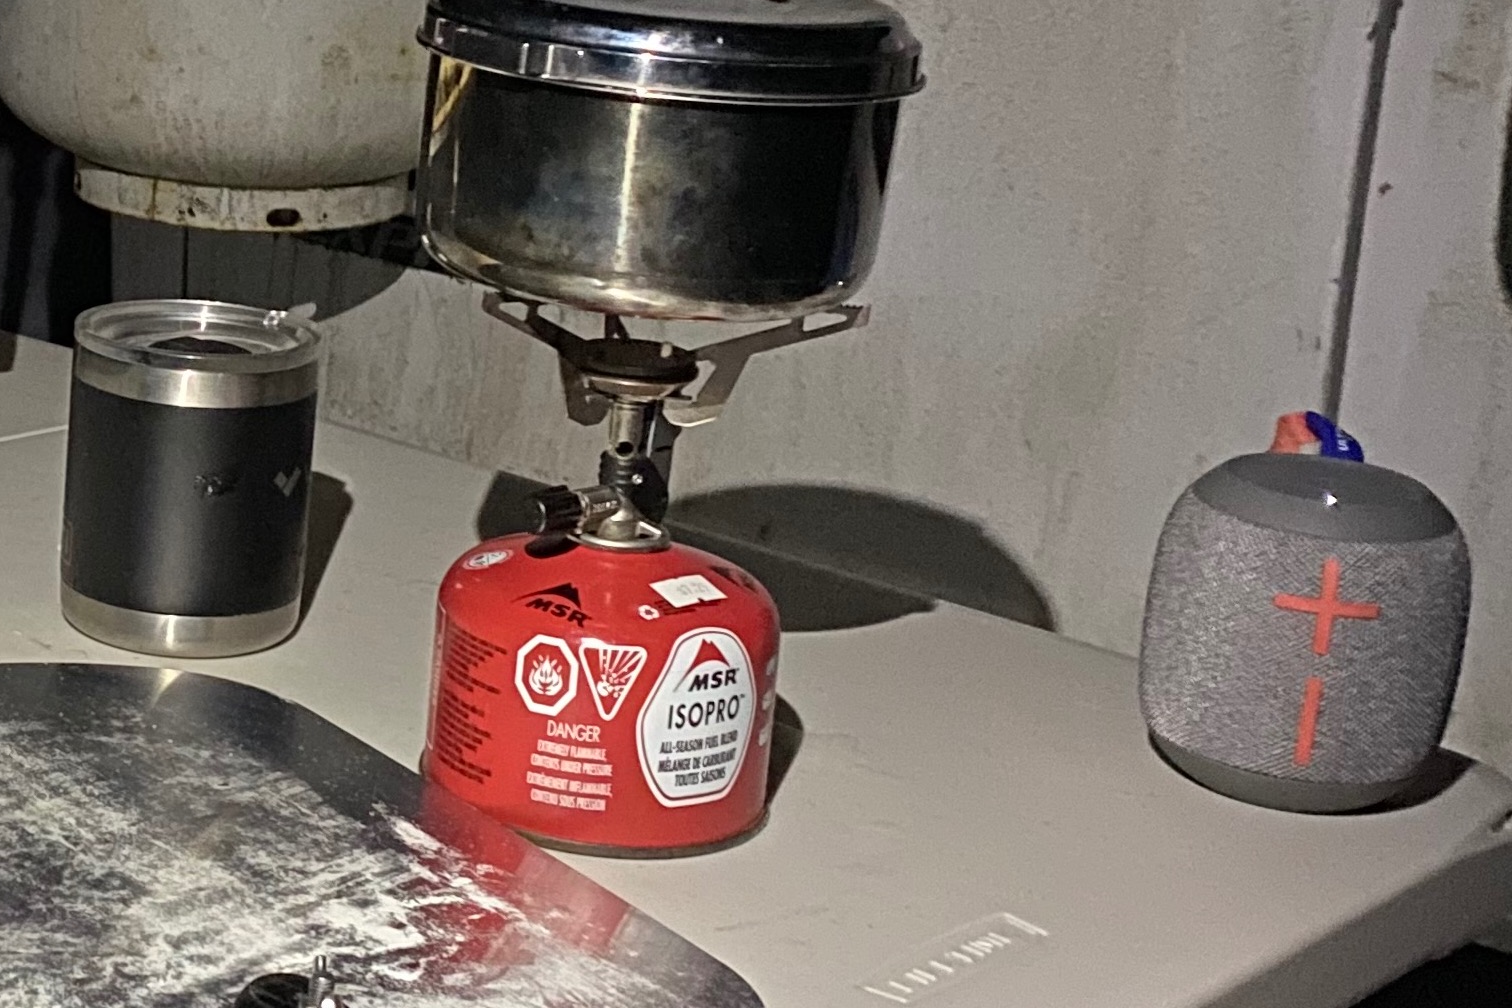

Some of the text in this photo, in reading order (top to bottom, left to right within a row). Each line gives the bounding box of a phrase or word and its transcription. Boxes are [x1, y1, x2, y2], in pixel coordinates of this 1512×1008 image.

[525, 597, 590, 628] MSR
[688, 669, 737, 693] MSR
[546, 719, 601, 743] DANGER
[659, 738, 703, 755] ALL-SEASON
[692, 755, 702, 770] DE
